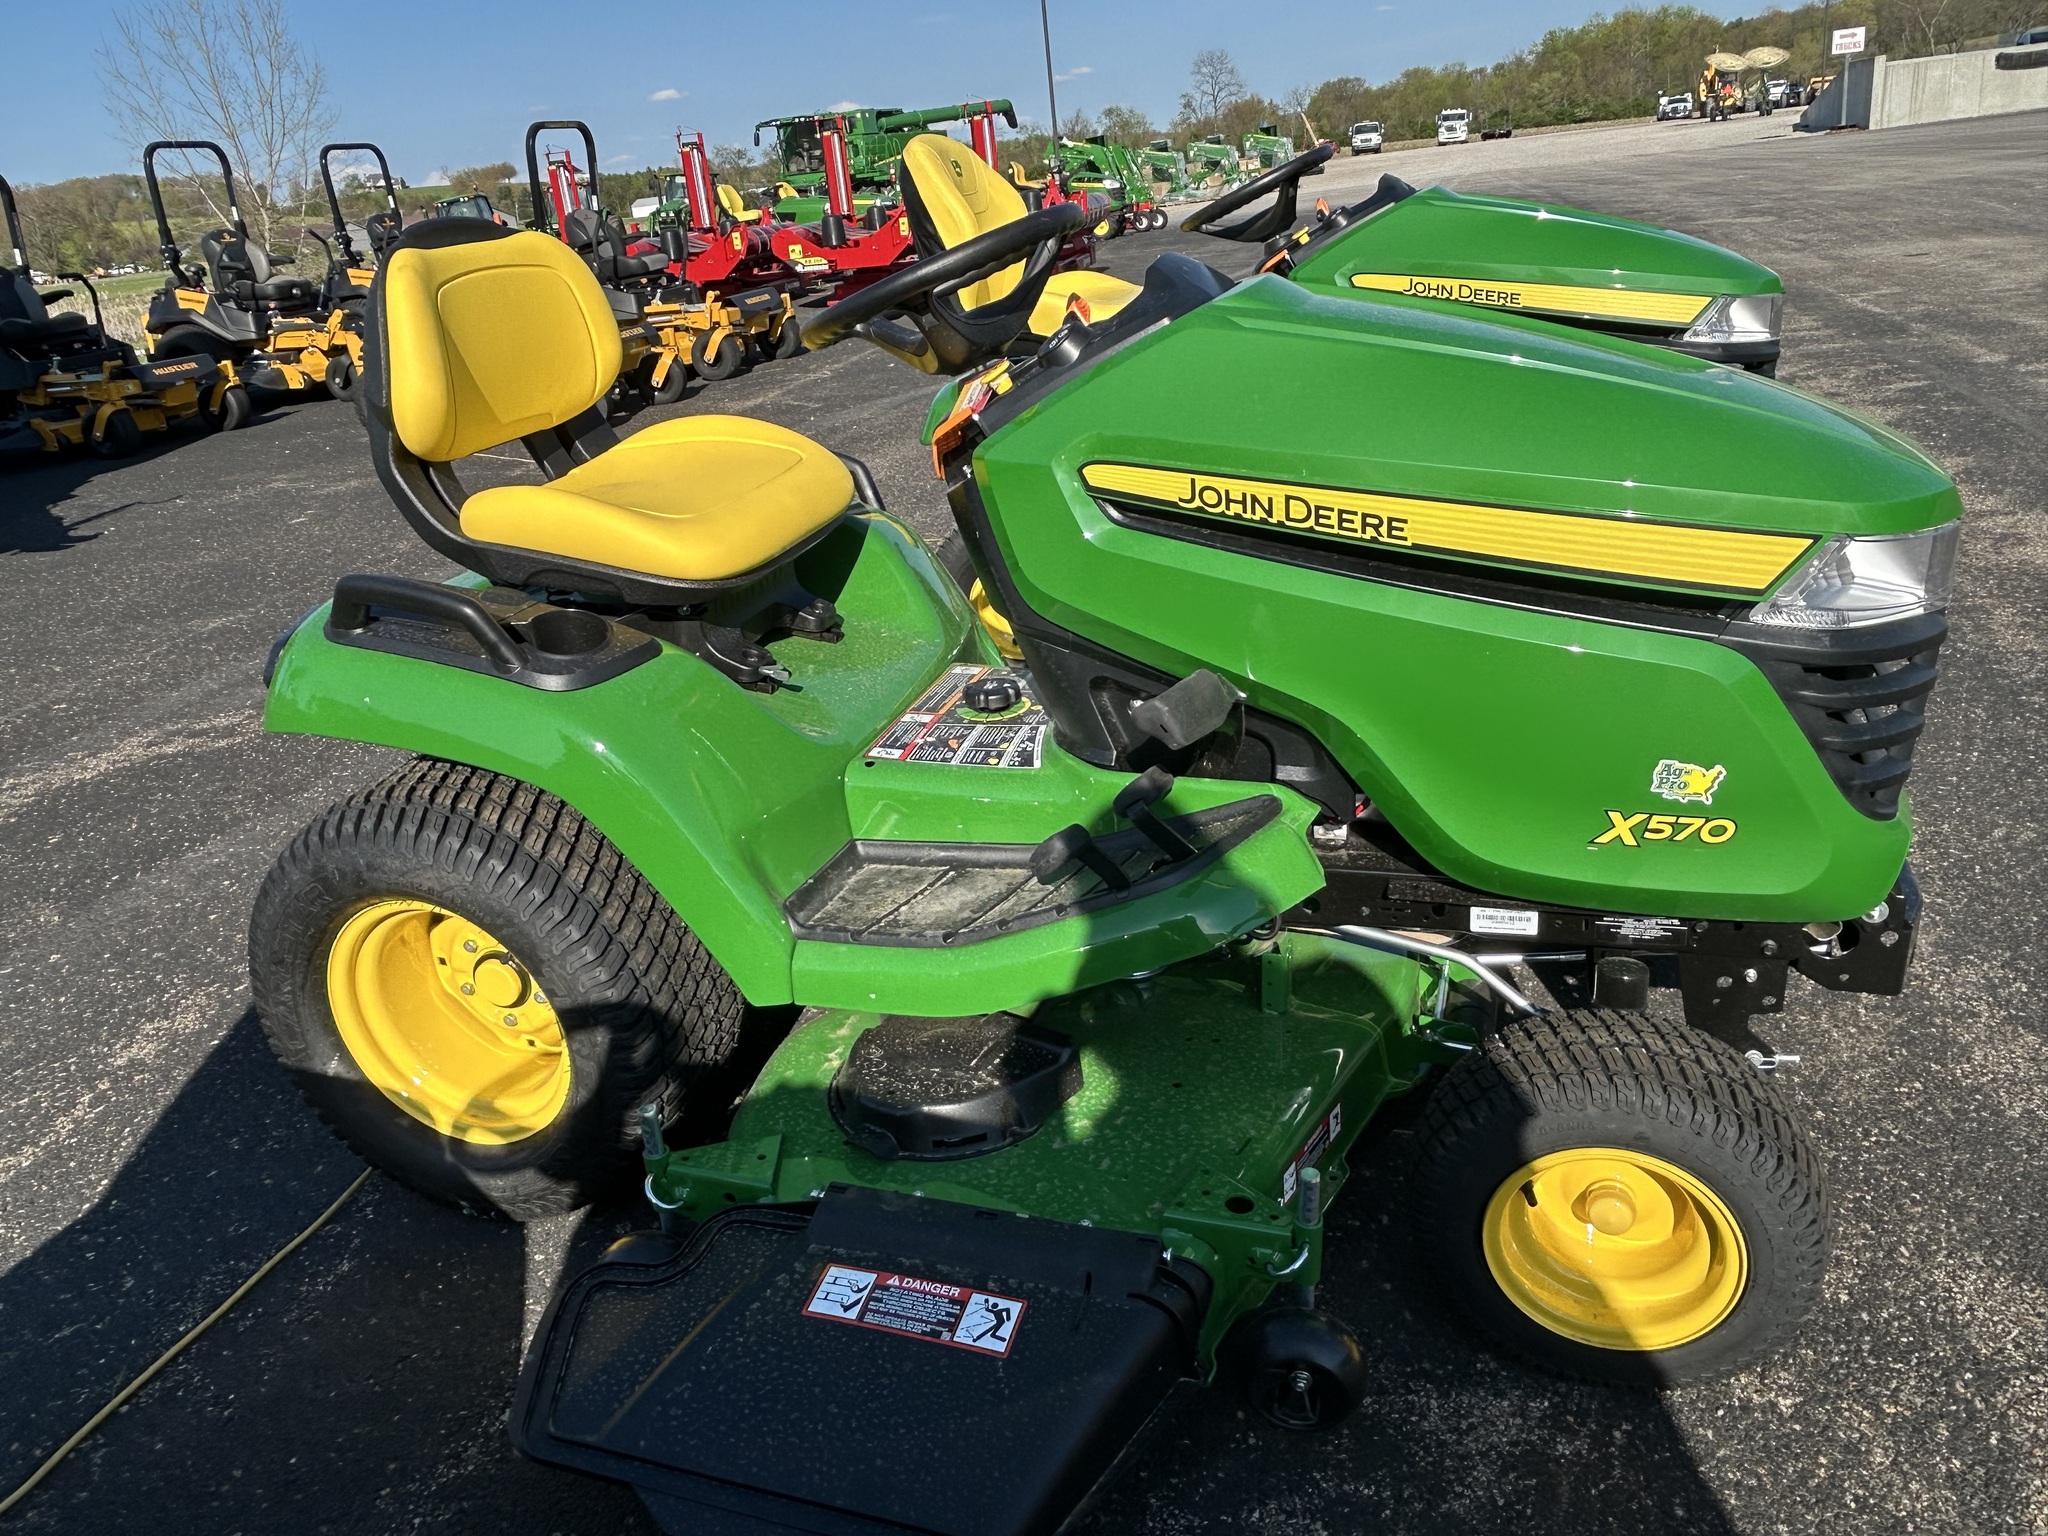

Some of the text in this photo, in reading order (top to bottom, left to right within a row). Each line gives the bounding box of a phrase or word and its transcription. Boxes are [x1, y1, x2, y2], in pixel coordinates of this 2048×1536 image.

[1403, 278, 1521, 305] JOHN DEERE
[1178, 477, 1408, 541] JOHN DEERE
[1656, 776, 1690, 791] Pro
[1588, 810, 1738, 848] X570
[901, 1277, 961, 1297] DANGER
